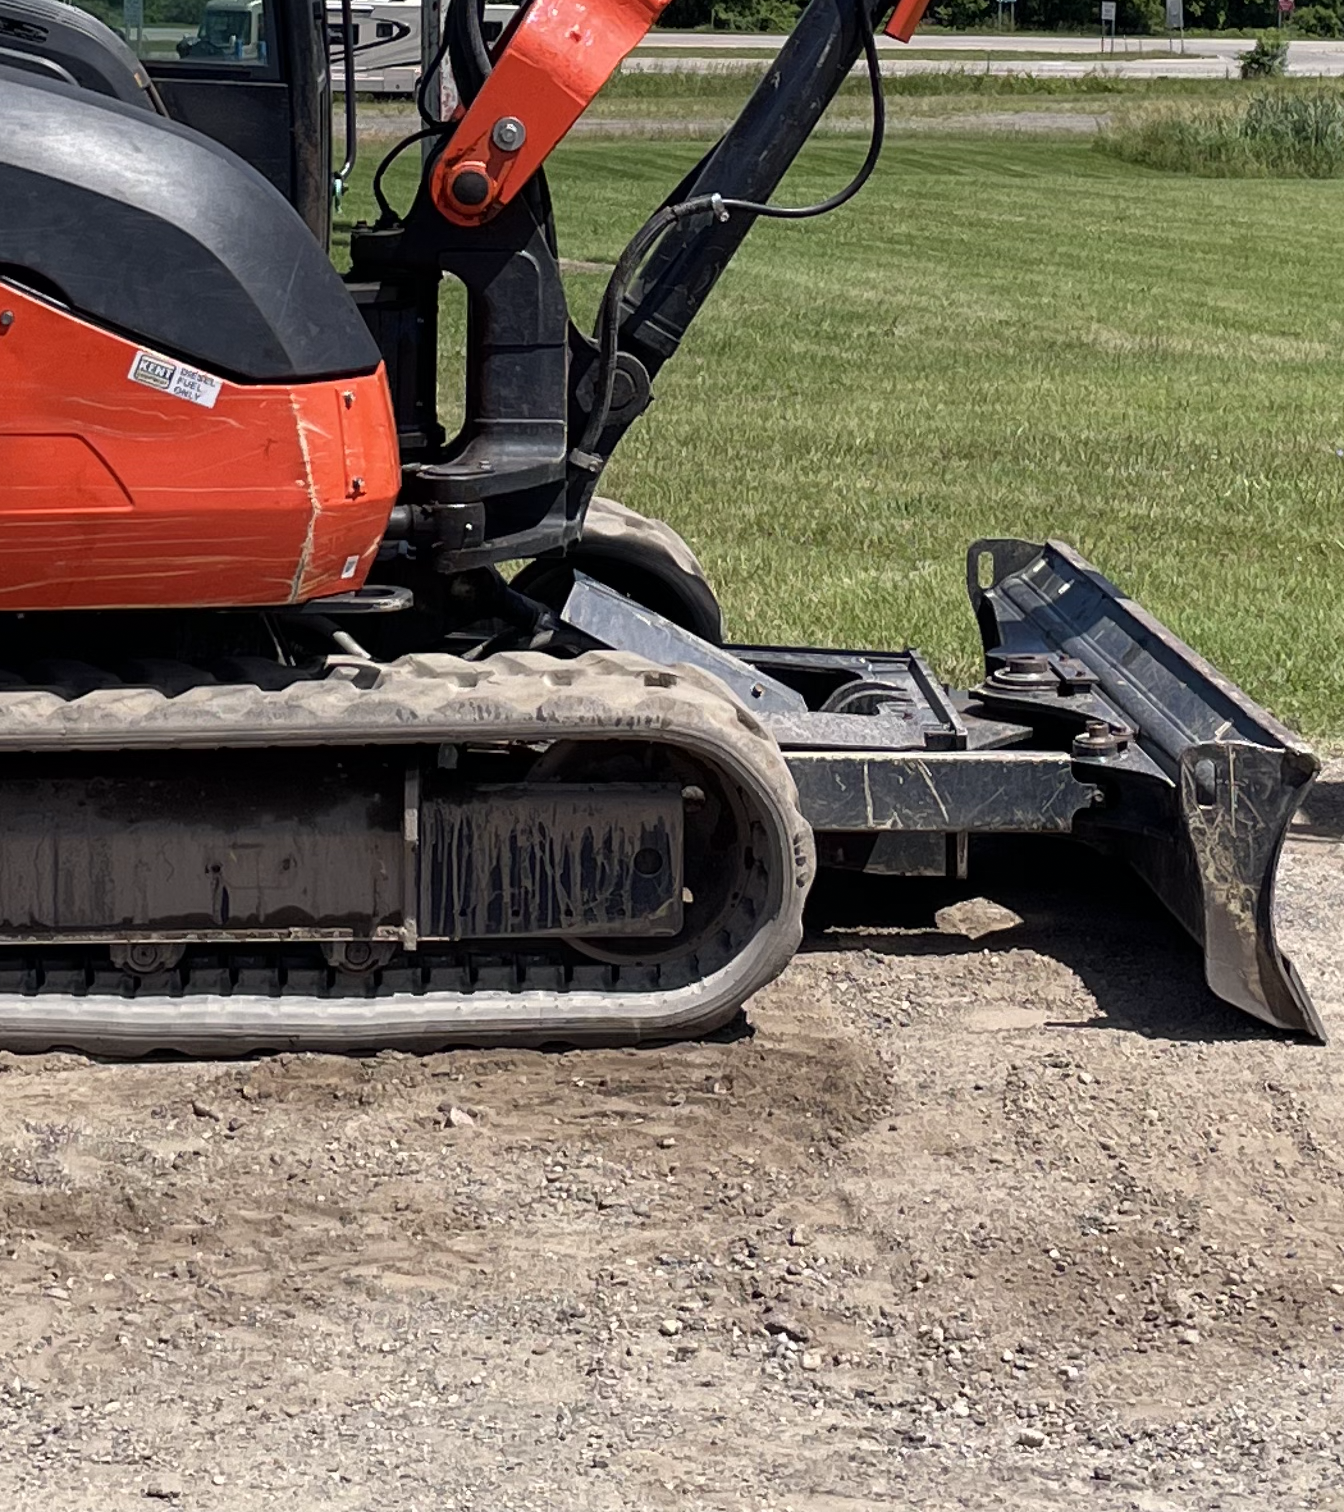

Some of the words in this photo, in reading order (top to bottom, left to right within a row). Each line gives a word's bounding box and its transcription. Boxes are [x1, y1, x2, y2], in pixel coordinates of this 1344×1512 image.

[140, 359, 174, 379] KENT
[181, 367, 216, 387] DIESEL
[176, 377, 202, 393] FUEL
